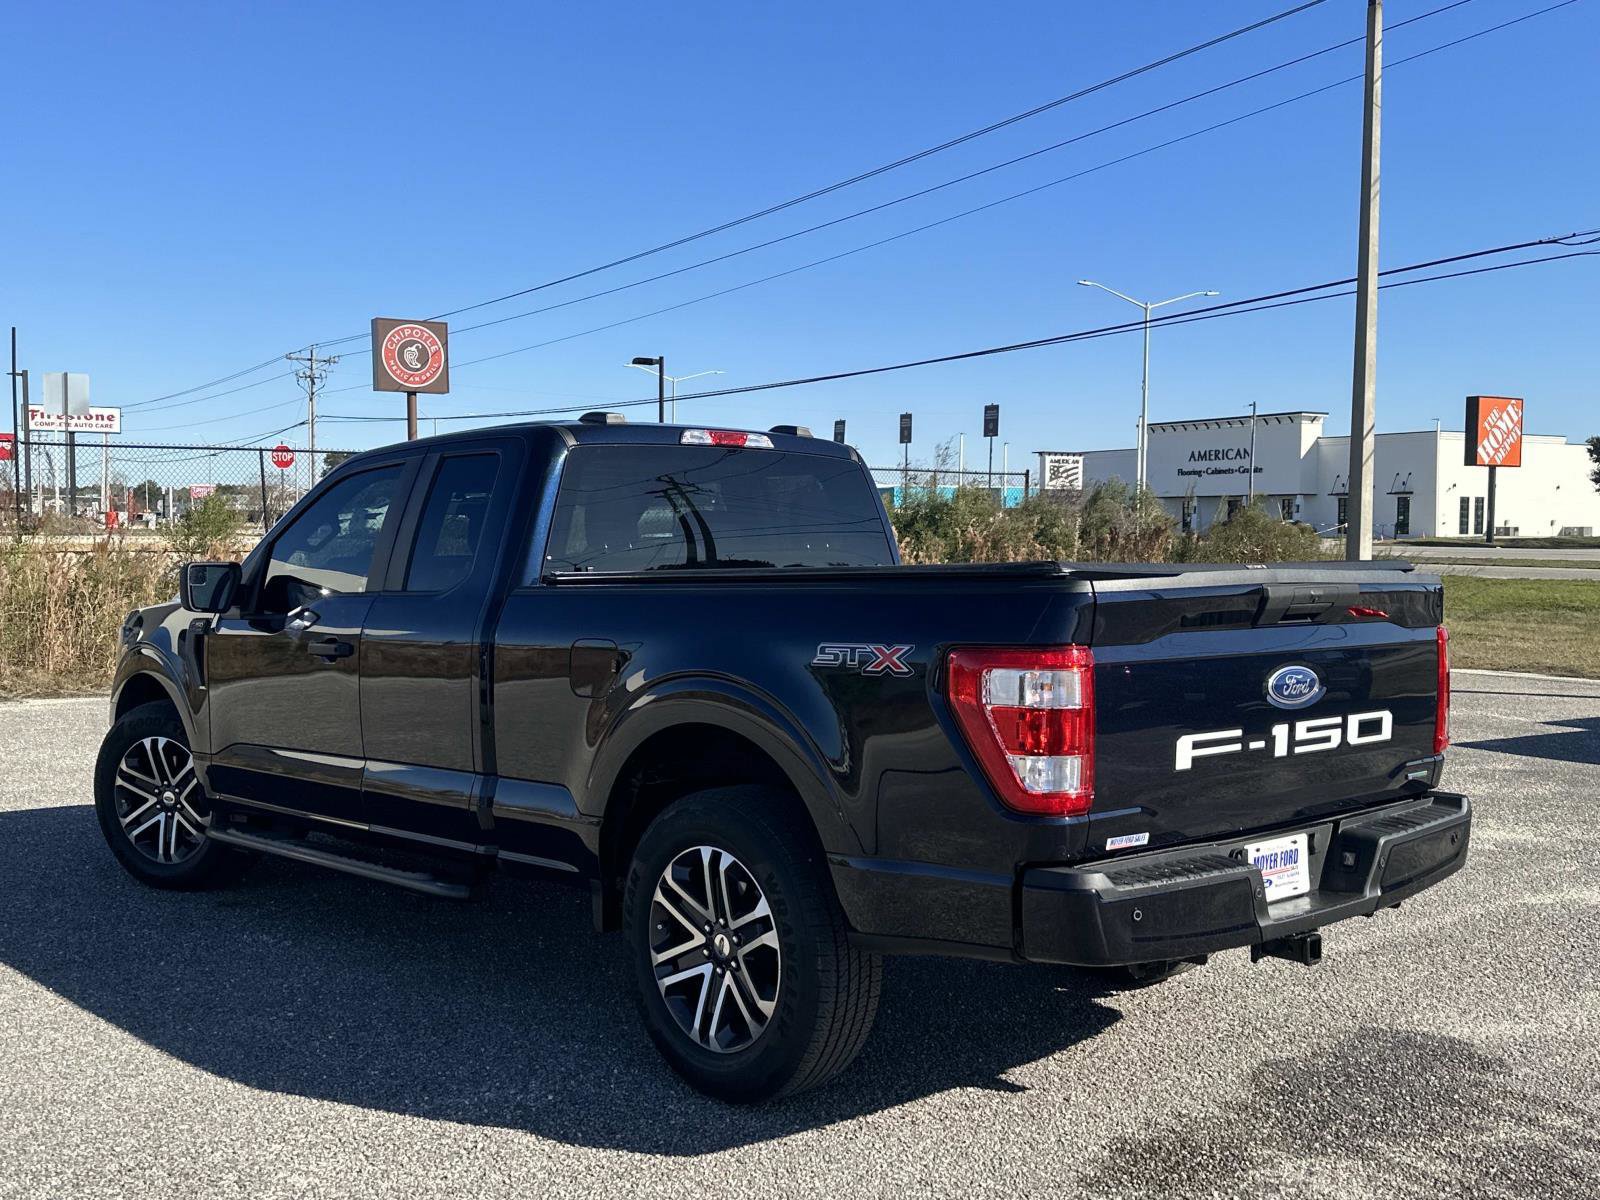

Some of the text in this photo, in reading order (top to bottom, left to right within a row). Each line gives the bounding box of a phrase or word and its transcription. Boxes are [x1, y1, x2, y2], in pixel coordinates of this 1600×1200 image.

[387, 328, 439, 353] CHIPOTLE
[388, 360, 439, 382] MEXICAN GRILL
[1483, 406, 1502, 431] THE
[1477, 400, 1522, 464] HOME
[1494, 423, 1521, 464] DEPOT
[272, 451, 294, 462] STOP
[1188, 447, 1250, 462] AMERICAN
[1238, 466, 1263, 474] Graite
[811, 641, 915, 677] STX
[1283, 674, 1310, 696] Ford
[1175, 710, 1393, 771] F-150
[1253, 848, 1299, 871] MOYER FORD
